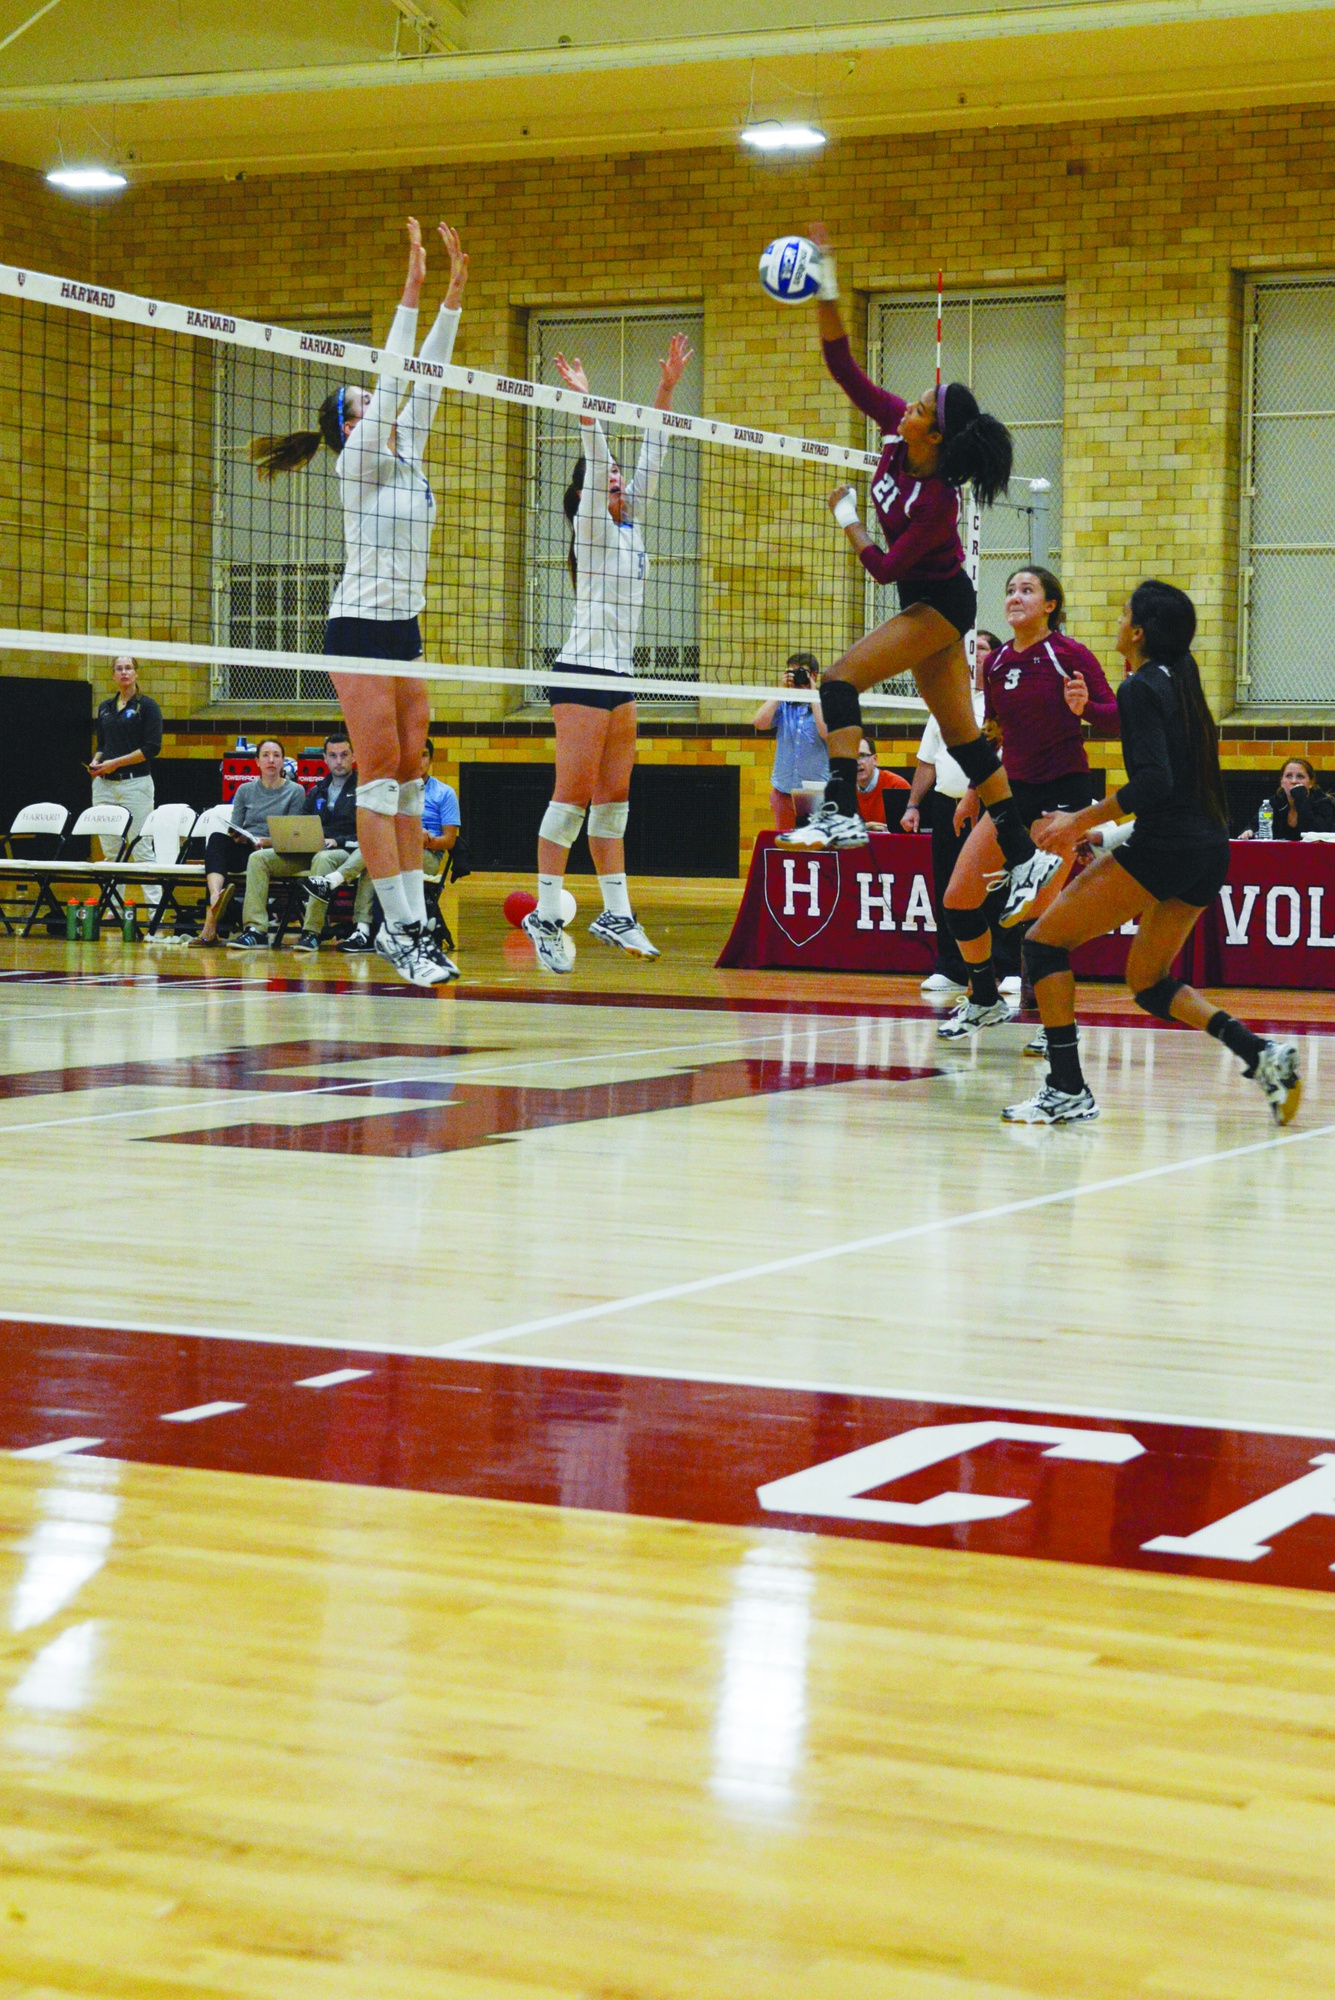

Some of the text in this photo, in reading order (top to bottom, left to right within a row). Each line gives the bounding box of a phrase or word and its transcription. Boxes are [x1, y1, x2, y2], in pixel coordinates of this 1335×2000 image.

[60, 282, 116, 309] HARVARD
[187, 310, 236, 334] HARVARD
[299, 335, 346, 358] HARVARD
[403, 358, 444, 378] HARVARD
[496, 378, 534, 398] HARVARD
[582, 396, 617, 415] HARVARD
[734, 428, 764, 445] HARVARD
[801, 441, 829, 457] HARVARD
[872, 472, 901, 515] 21
[22, 812, 61, 822] HARVARD
[83, 813, 122, 823] HARVARD
[783, 859, 820, 917] H
